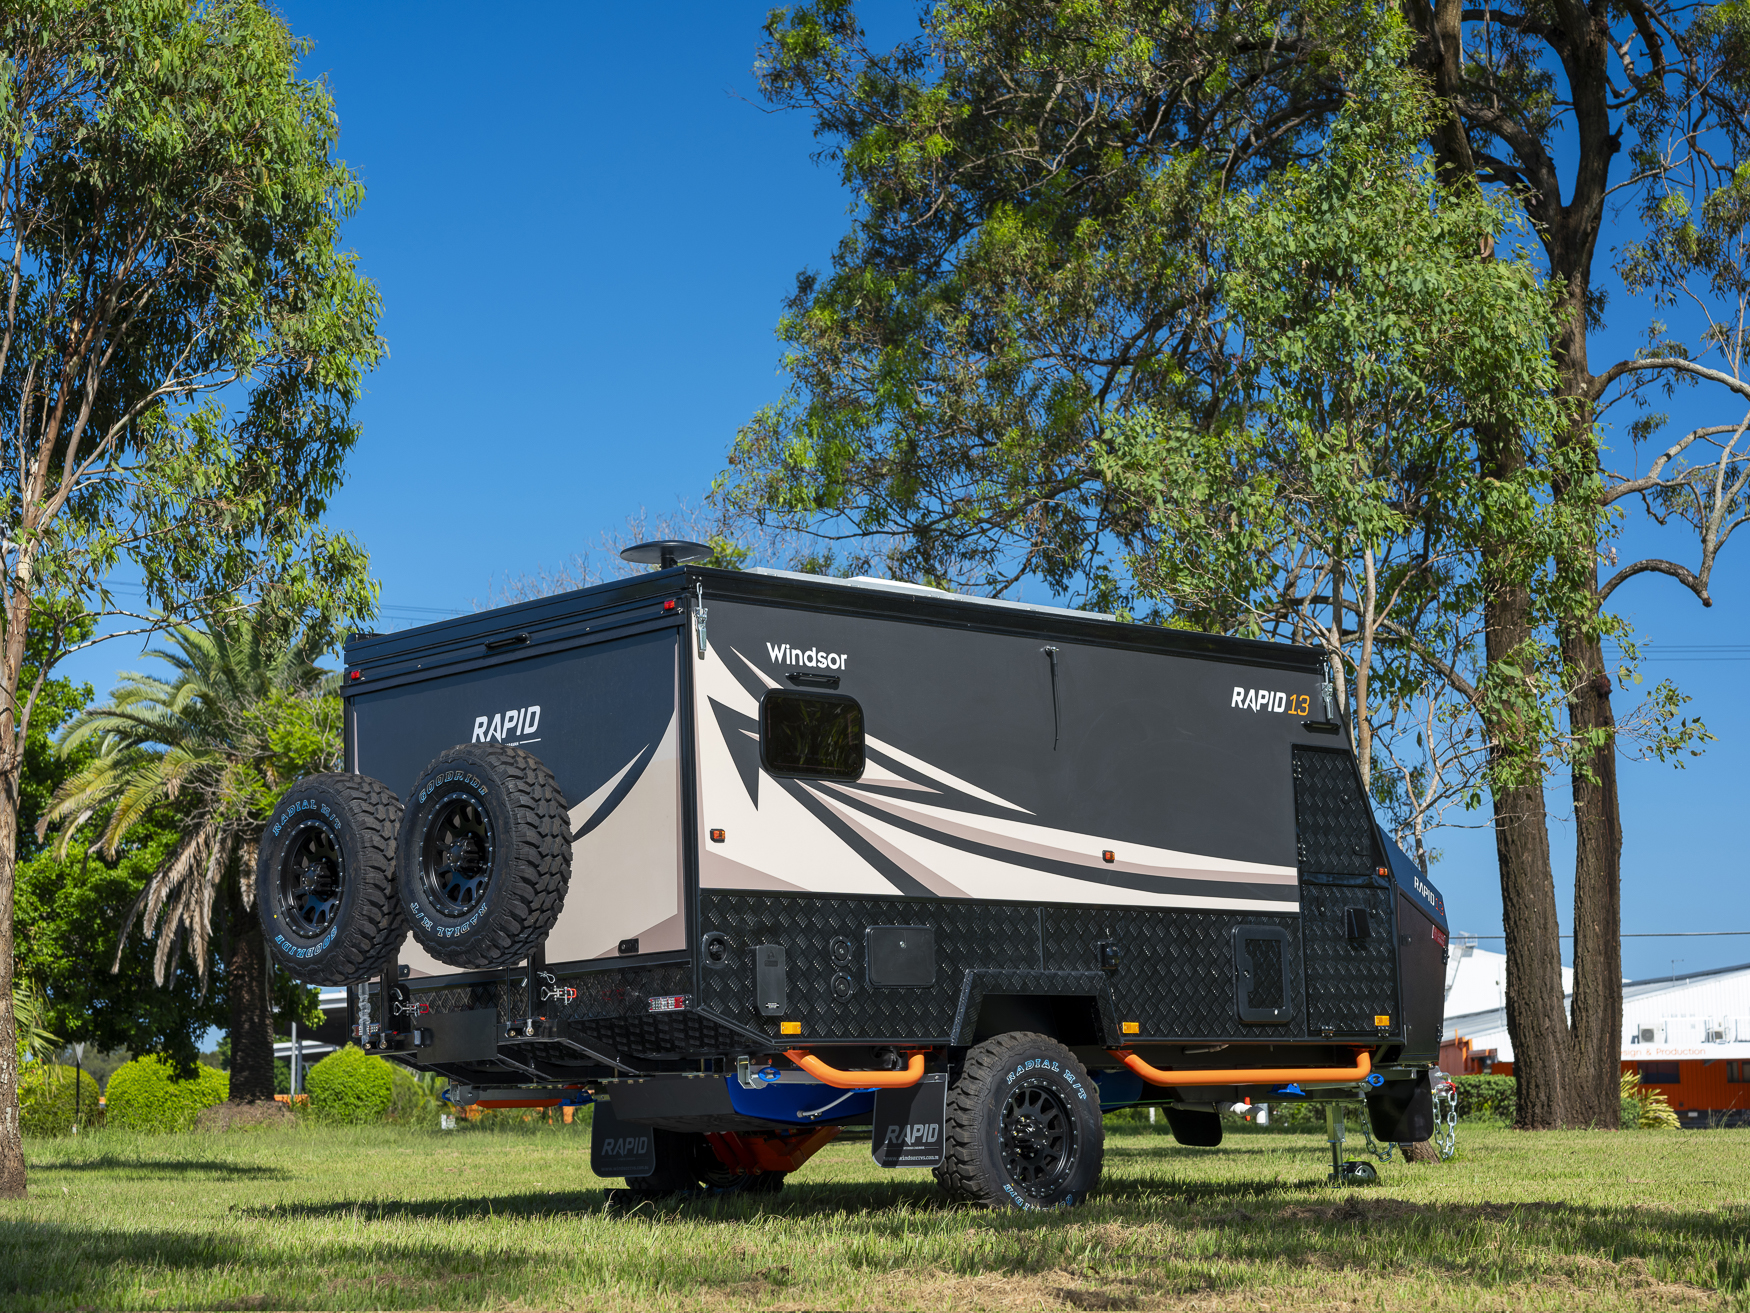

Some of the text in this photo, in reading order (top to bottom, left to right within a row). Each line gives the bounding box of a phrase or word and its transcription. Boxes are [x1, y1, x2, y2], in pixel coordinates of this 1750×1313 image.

[766, 642, 848, 670] Windsor
[1231, 686, 1310, 716] RAPID 13
[471, 705, 541, 743] RAPID
[418, 770, 489, 804] GOODRIDE
[272, 799, 342, 837] RADIAL M/T
[1413, 875, 1444, 916] RAPID 13
[436, 902, 488, 938] RADIAL
[274, 925, 338, 959] GOODRIDE
[1620, 1049, 1642, 1058] sign
[1656, 1047, 1706, 1056] Production
[1006, 1058, 1087, 1100] RADIAL M/T
[601, 1136, 648, 1157] RAPID
[884, 1123, 939, 1146] RAPID
